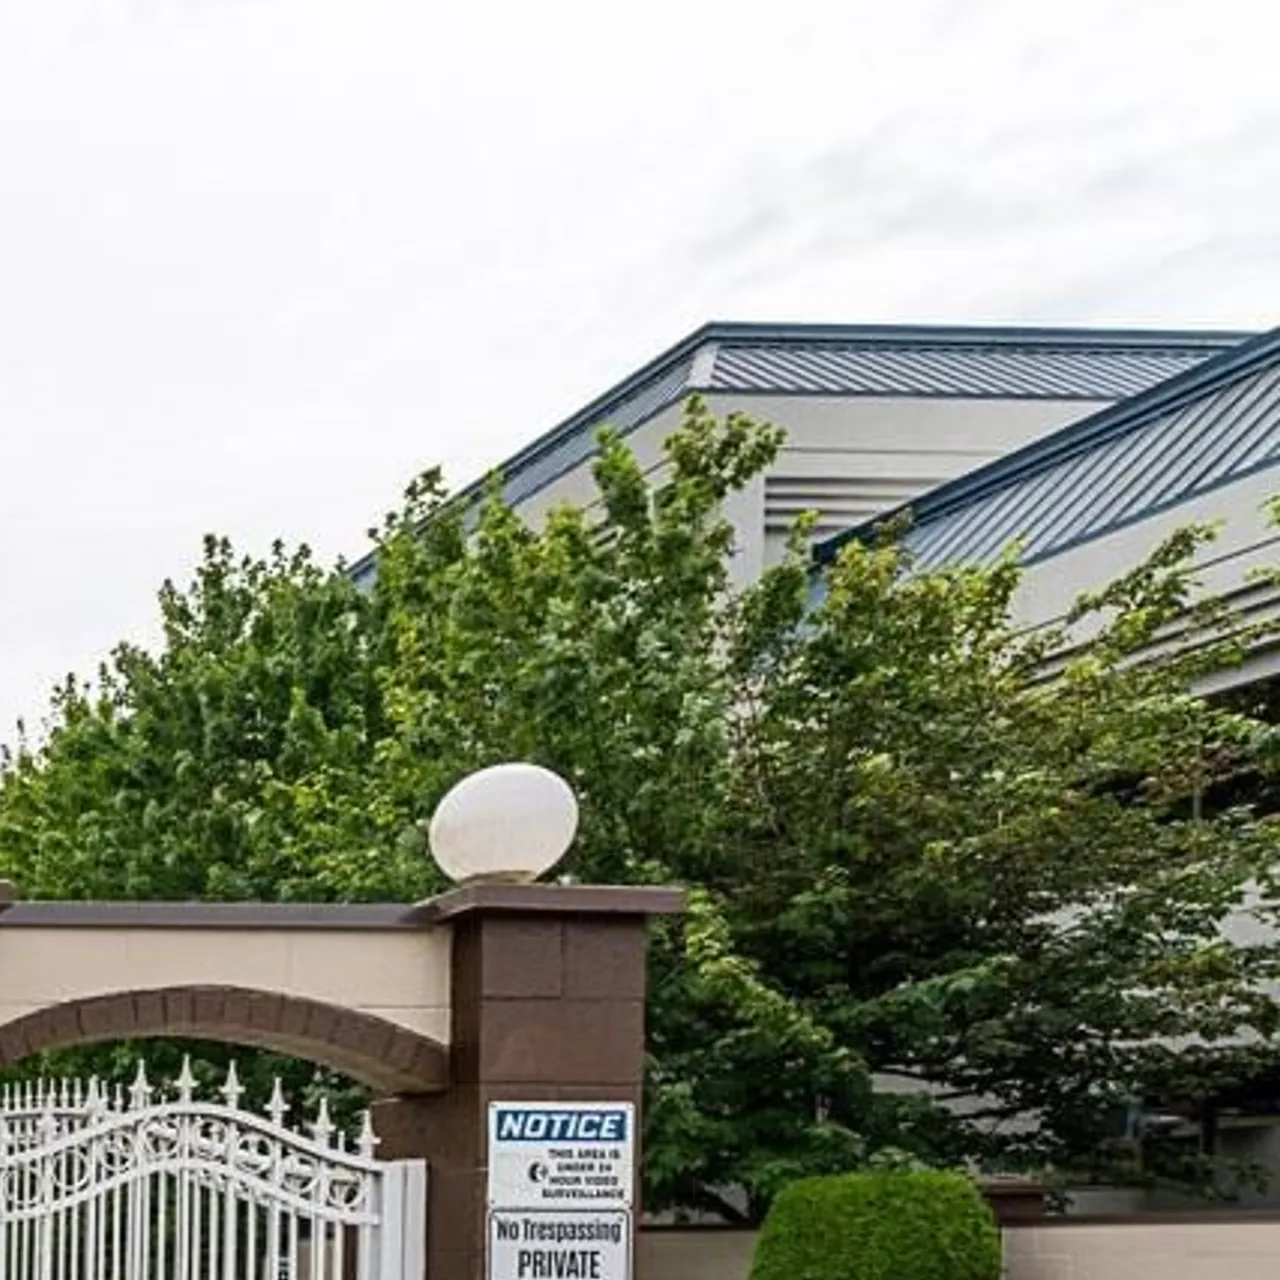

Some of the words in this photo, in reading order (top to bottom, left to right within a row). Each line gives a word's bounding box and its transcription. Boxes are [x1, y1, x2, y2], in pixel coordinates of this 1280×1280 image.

[500, 1113, 622, 1139] NOTICE
[497, 1220, 519, 1240] No
[522, 1219, 622, 1244] Trespassing
[518, 1250, 600, 1279] PRIVATE
